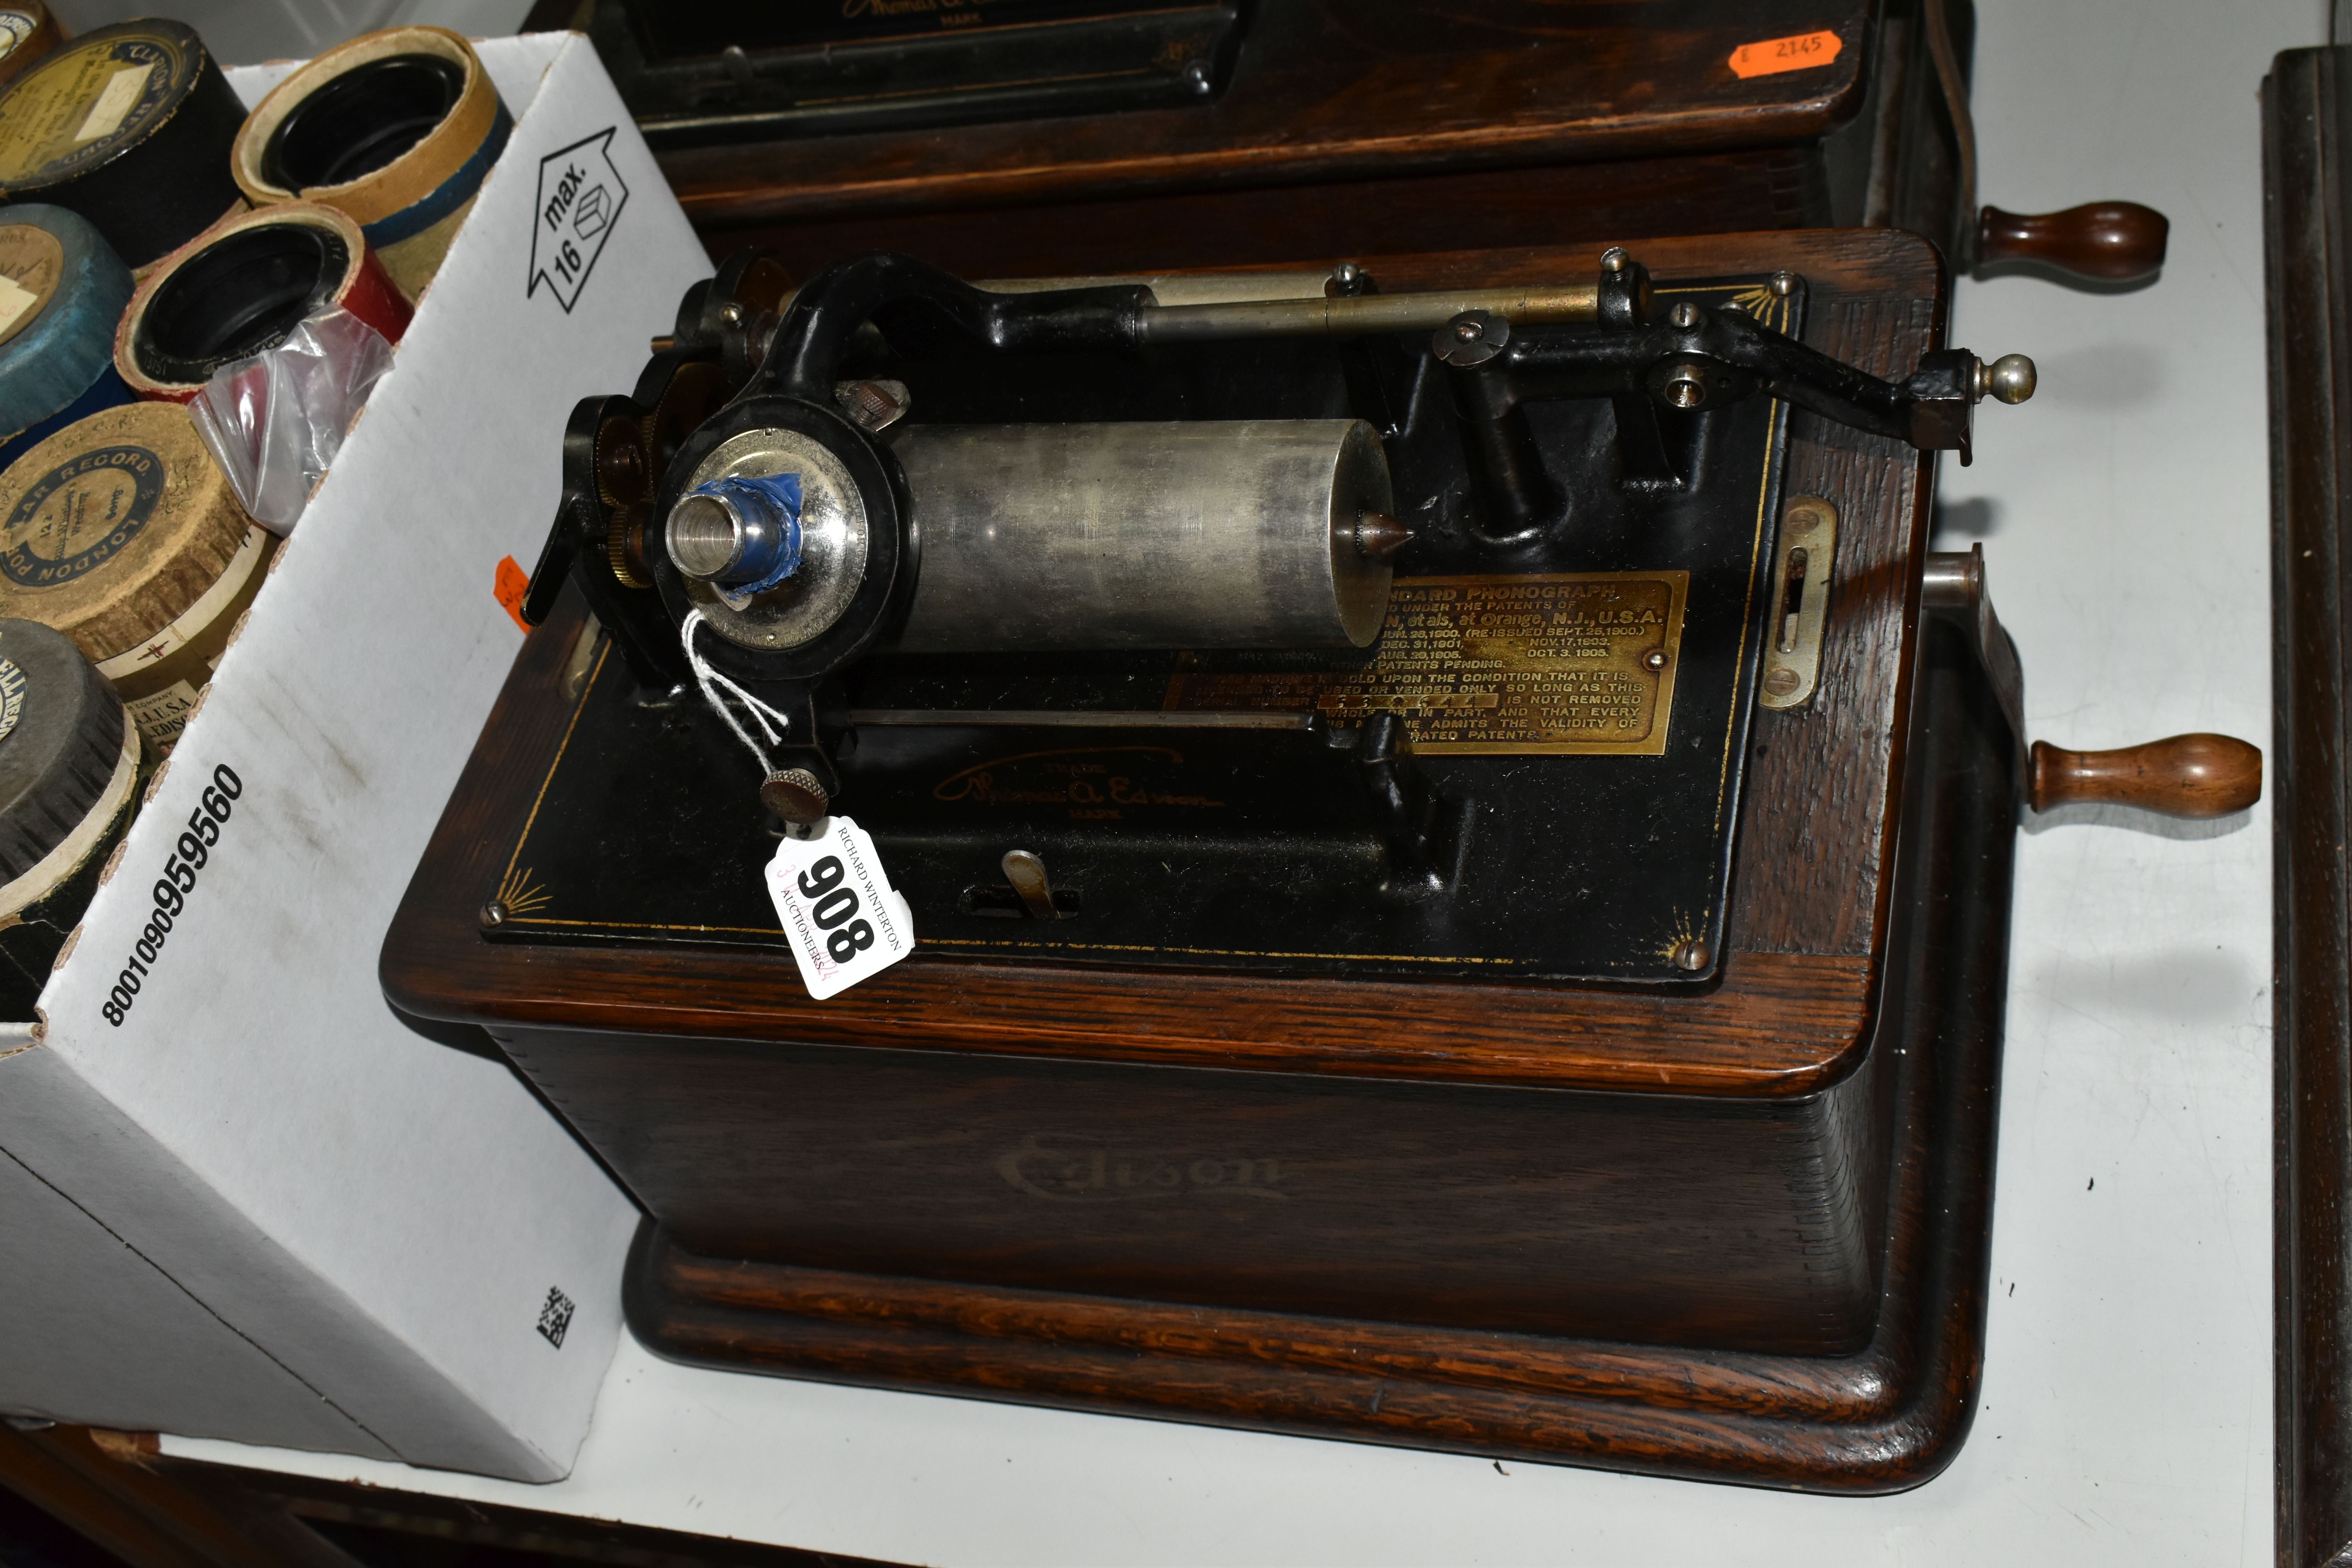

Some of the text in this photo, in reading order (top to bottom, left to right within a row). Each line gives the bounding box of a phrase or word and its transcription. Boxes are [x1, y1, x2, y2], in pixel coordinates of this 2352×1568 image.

[1776, 36, 1822, 58] 2145
[544, 163, 586, 232] max.
[555, 239, 581, 285] 16
[39, 519, 139, 581] LONDON
[1390, 584, 1615, 602] NDARD PHONOGRAPH
[1402, 603, 1450, 612] UNDER
[1455, 602, 1482, 610] THE
[1486, 601, 1552, 610] PATENTS
[1558, 601, 1577, 609] OF
[1407, 613, 1425, 627] et
[1426, 612, 1454, 628] als,
[1459, 612, 1476, 626] at
[1480, 613, 1546, 628] Orange,
[1599, 610, 1663, 624] U.S.A.
[1466, 628, 1542, 639] (RE-ISSUED
[1377, 651, 1407, 660] AUG.
[1527, 649, 1556, 658] OCT.
[1377, 660, 1442, 670] PATENTS
[1443, 660, 1506, 669] PENDING.
[1339, 674, 1376, 683] SOLD
[1382, 674, 1421, 683] UPON
[1428, 673, 1454, 682] THE
[1462, 673, 1540, 682] CONDITION
[1548, 672, 1587, 681] THAT
[1592, 672, 1608, 681] IT
[1613, 671, 1629, 681] IS
[1323, 685, 1361, 694] USED
[1368, 685, 1388, 694] OR
[1395, 684, 1451, 694] VENDED
[1459, 684, 1495, 693] ONLY
[1506, 684, 1525, 693] SO
[1533, 683, 1572, 692] LONG
[1579, 683, 1600, 692] AS
[1607, 683, 1643, 692] THIS
[135, 690, 176, 709] COMPANY.
[1252, 697, 1310, 706] NUMBER
[1507, 695, 1521, 704] IS
[1530, 695, 1557, 704] NOT
[1569, 695, 1642, 704] REMOVED
[1418, 708, 1432, 717] IN
[1446, 708, 1486, 717] PART,
[1498, 707, 1528, 717] AND
[1541, 707, 1579, 717] THAT
[1591, 707, 1640, 716] EVERY
[1432, 719, 1488, 728] ADMITS
[1500, 719, 1527, 728] THE
[1540, 719, 1606, 728] VALIDITY
[1619, 719, 1639, 728] OF
[1045, 763, 1107, 774] TRADE
[1068, 780, 1105, 804] A
[1108, 776, 1226, 807] Edison
[1069, 809, 1124, 819] MARK
[102, 763, 243, 1027] 8001090959560
[838, 826, 902, 952] RICHARD WINTERTON
[797, 855, 875, 964] 908
[781, 889, 824, 970] AUCTIONEERS
